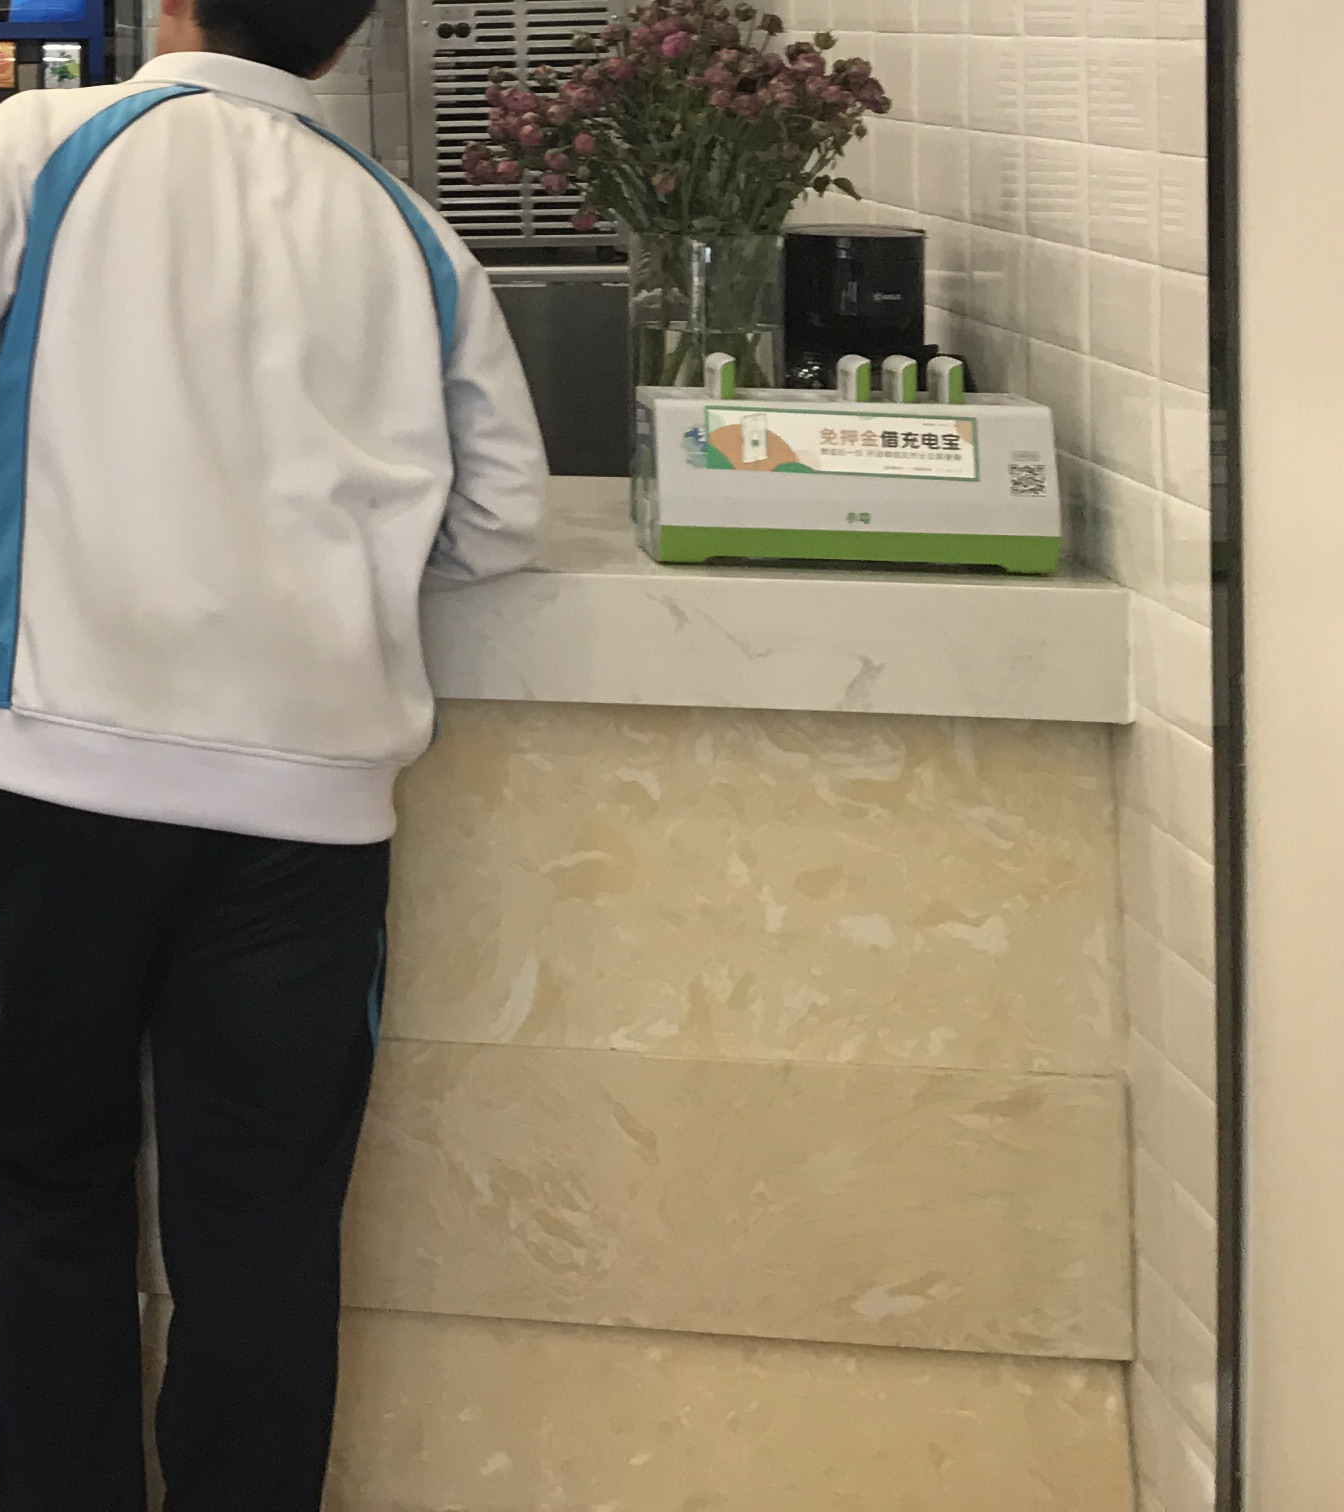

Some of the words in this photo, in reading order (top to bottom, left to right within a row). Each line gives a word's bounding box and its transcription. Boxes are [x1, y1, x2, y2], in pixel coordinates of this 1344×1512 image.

[820, 428, 961, 451] 免押金借充电宝
